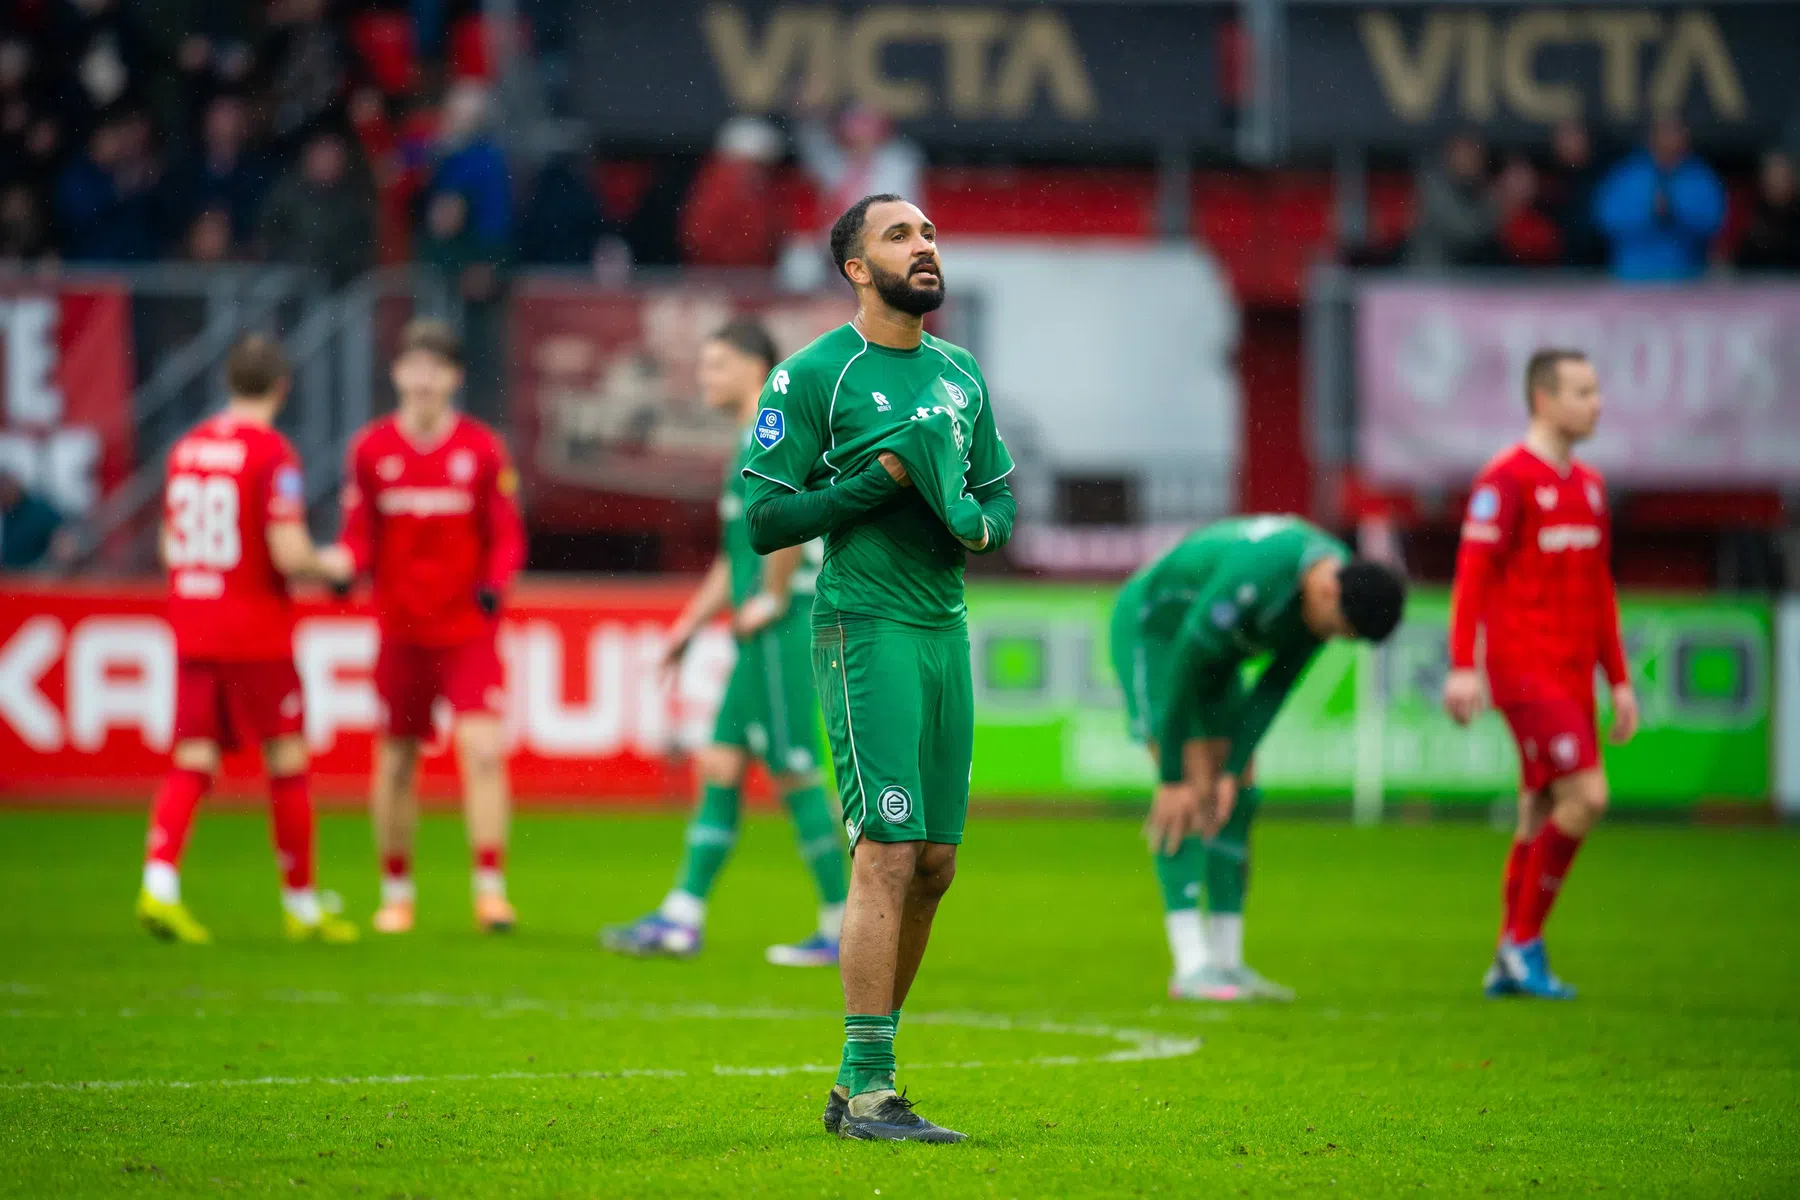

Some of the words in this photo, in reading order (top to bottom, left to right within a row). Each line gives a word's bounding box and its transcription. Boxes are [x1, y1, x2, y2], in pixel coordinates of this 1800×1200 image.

[704, 4, 1097, 121] VICTA
[1358, 7, 1748, 124] VICTA
[166, 473, 243, 573] 38
